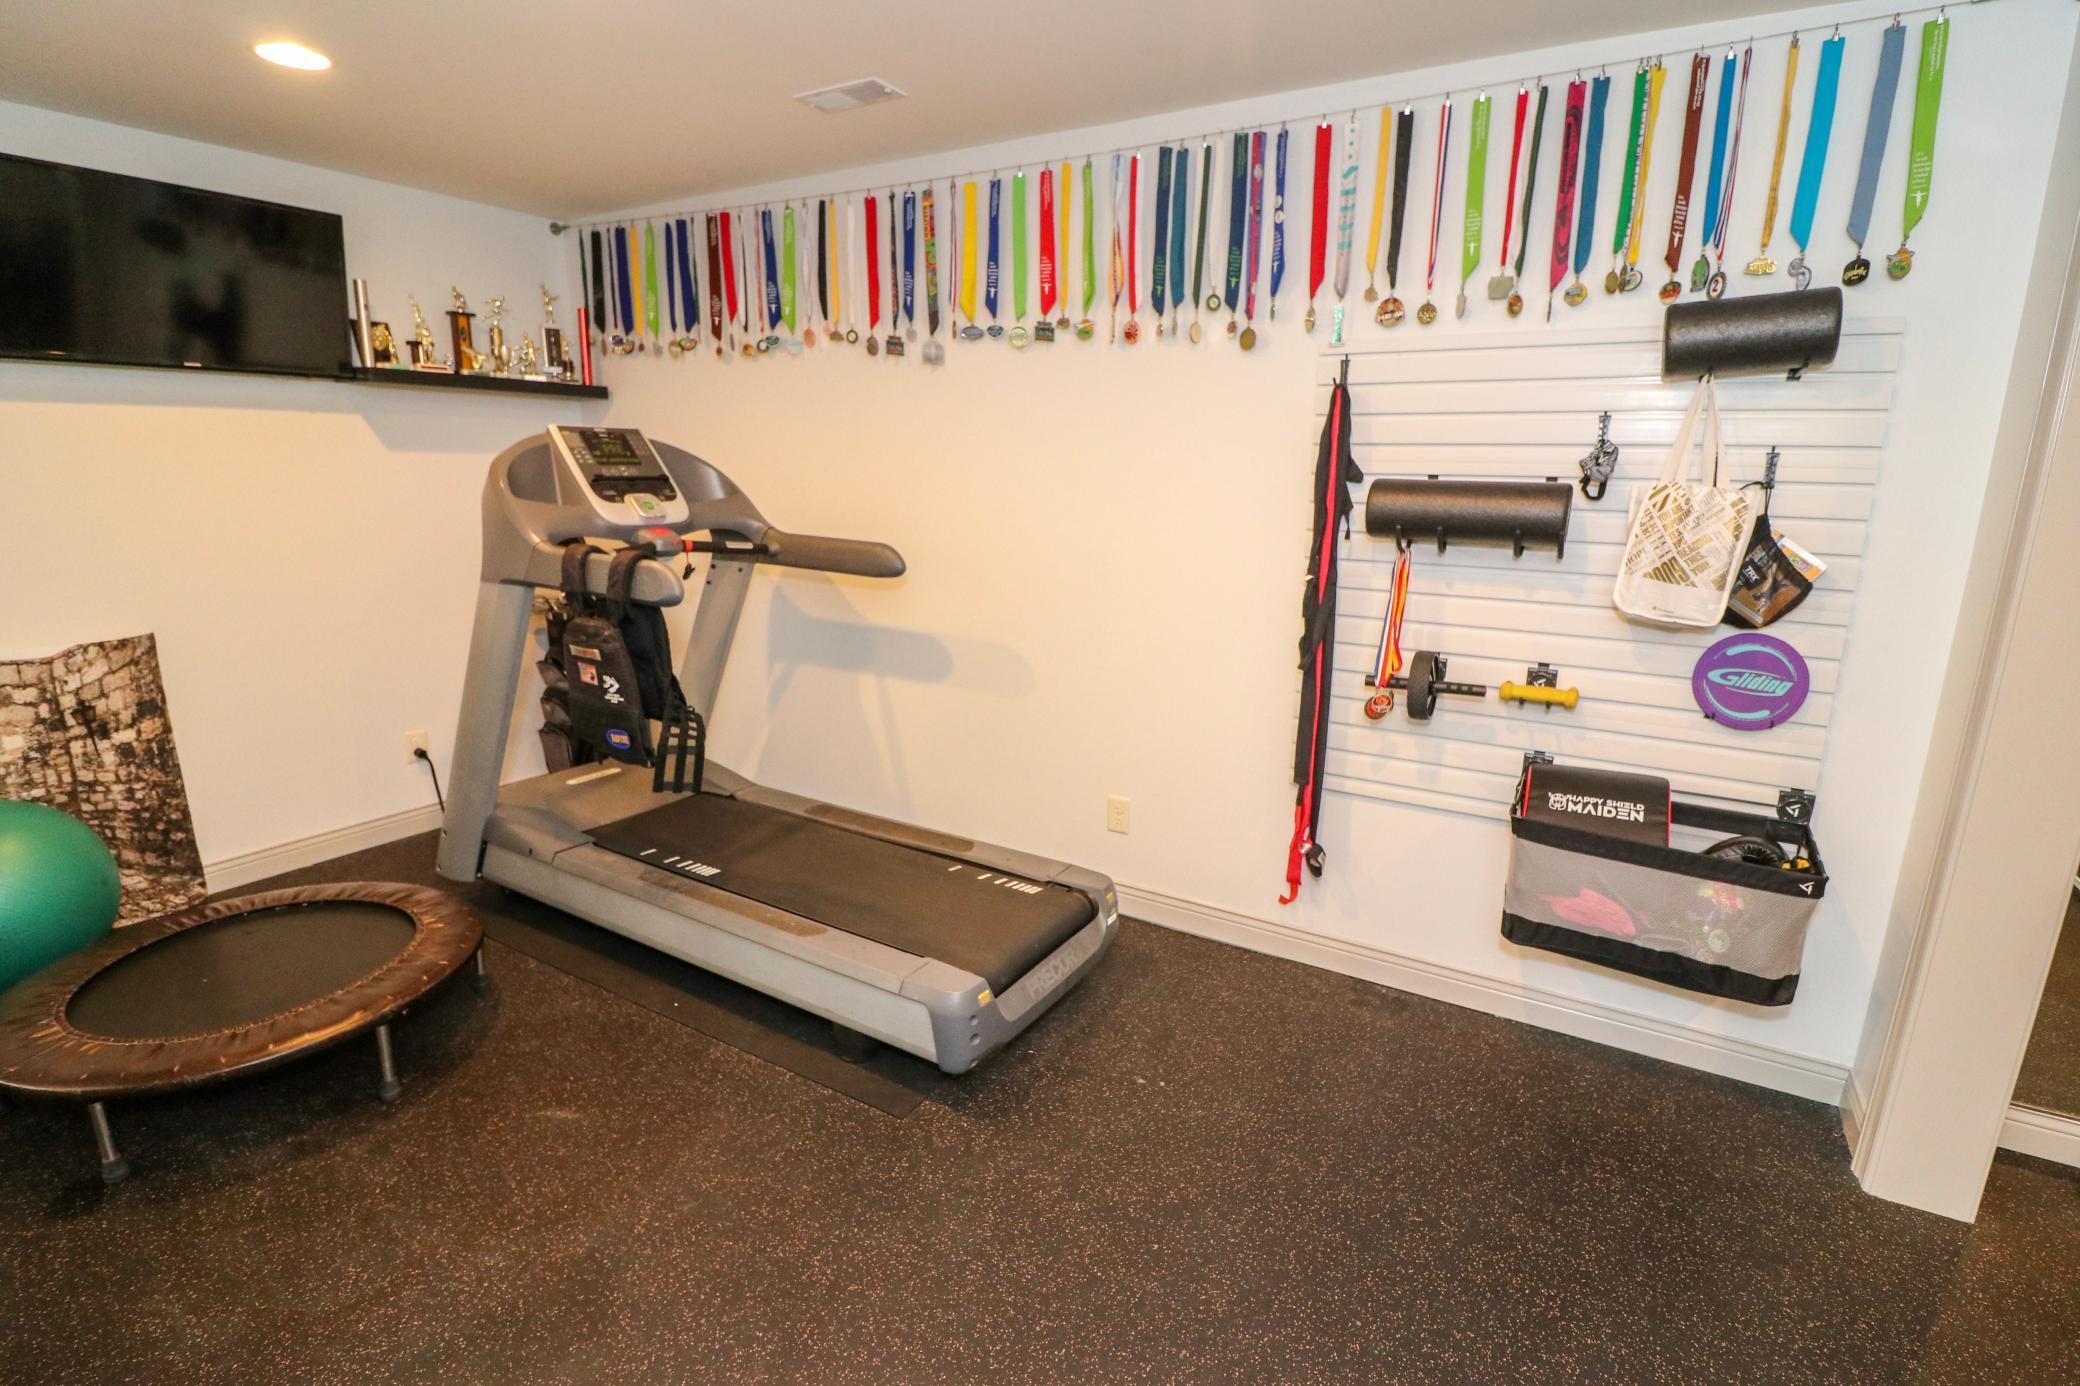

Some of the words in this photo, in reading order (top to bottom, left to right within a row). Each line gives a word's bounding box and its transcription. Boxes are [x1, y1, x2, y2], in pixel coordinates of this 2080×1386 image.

[1707, 668, 1794, 697] Gliding
[1567, 802, 1645, 823] MAIDEN
[1569, 794, 1604, 805] HAPPY
[1606, 799, 1645, 810] SHIELD
